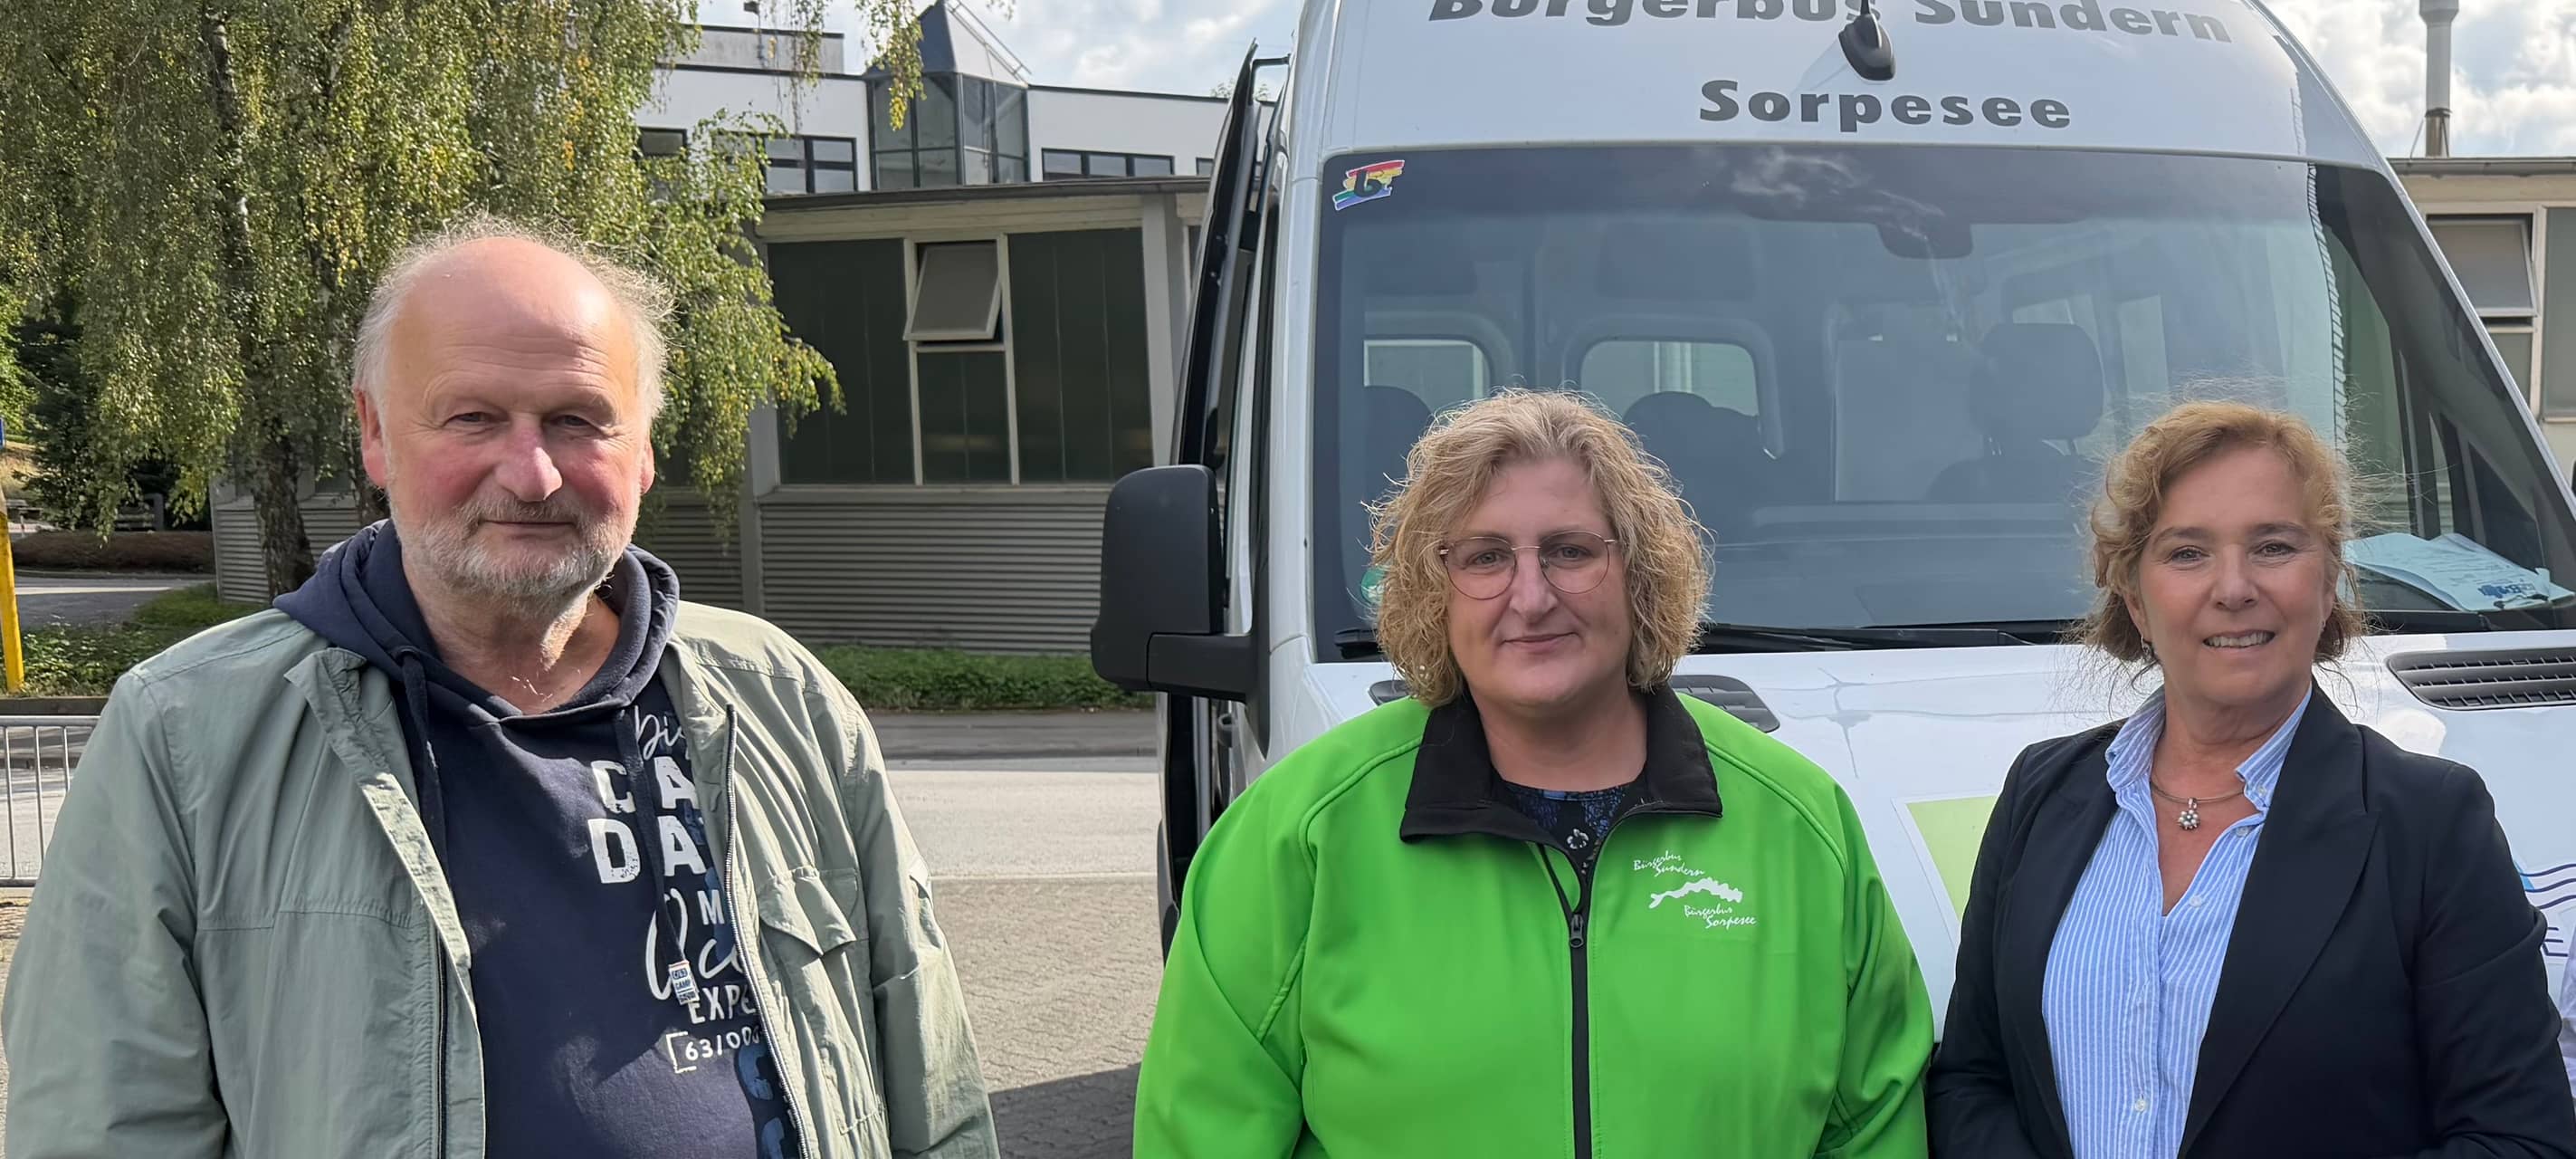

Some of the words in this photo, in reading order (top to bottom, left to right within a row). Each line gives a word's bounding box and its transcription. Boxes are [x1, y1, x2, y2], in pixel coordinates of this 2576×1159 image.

[1915, 0, 2232, 43] Sundern
[1700, 79, 2071, 133] Sorpesee
[1633, 849, 1682, 871] Bürgerbus
[1654, 862, 1705, 877] Sundern
[1684, 903, 1733, 919] Bürgerbus
[1704, 915, 1757, 931] Sorpesee
